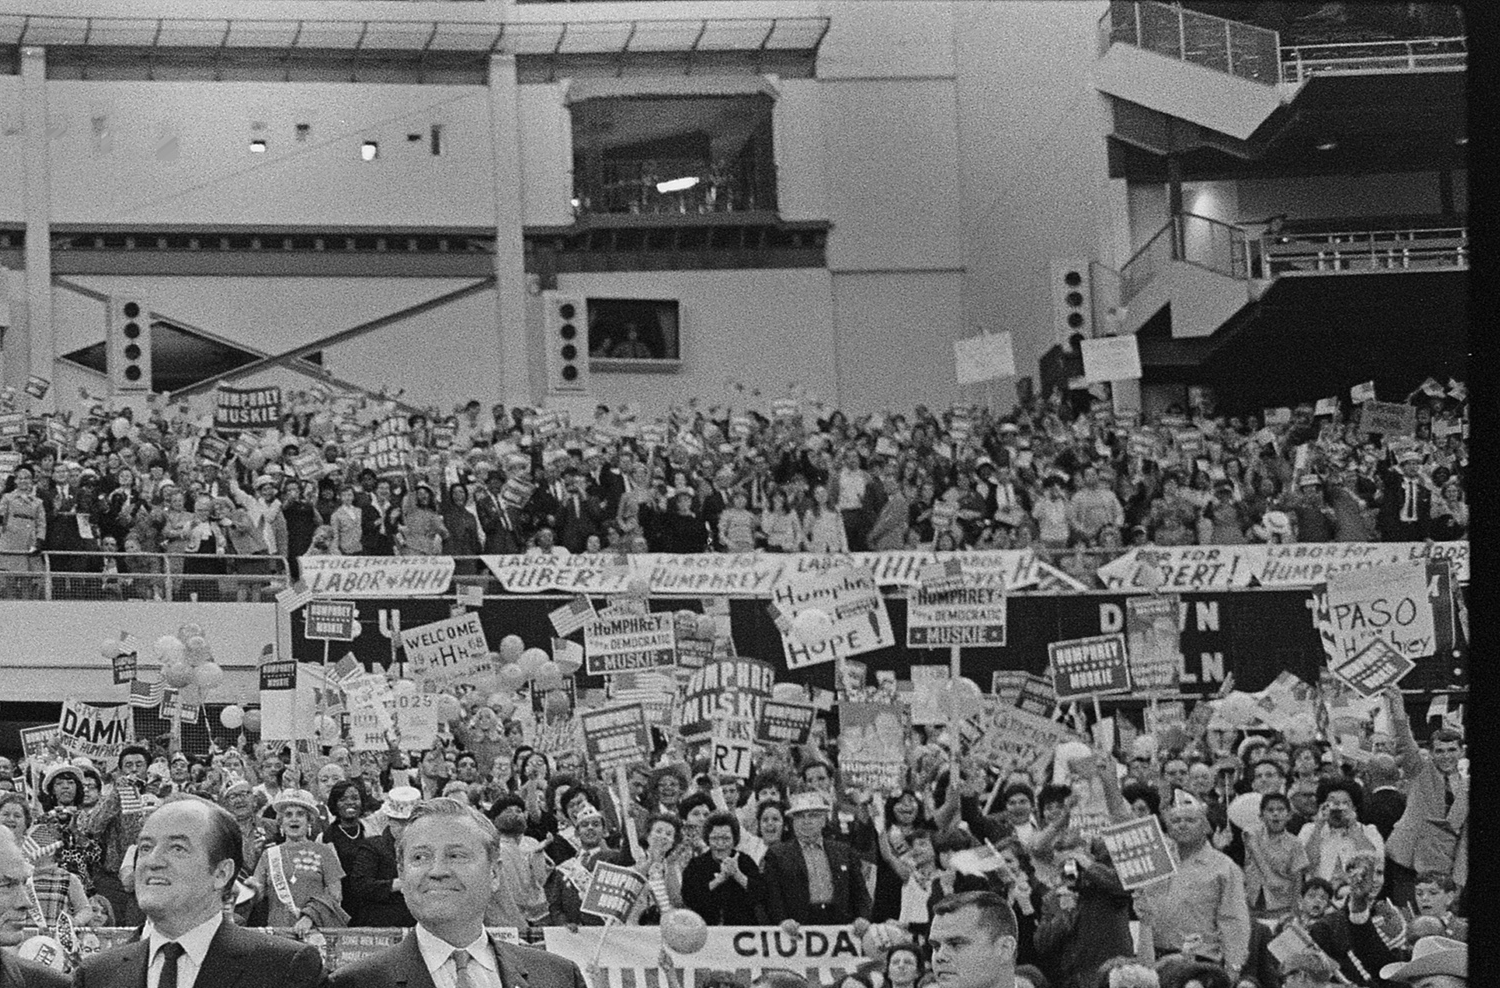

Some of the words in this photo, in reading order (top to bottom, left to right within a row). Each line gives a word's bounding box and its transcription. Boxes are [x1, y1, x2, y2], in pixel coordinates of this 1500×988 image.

[217, 406, 279, 423] MUSKIE
[498, 555, 561, 567] LABOR
[1266, 546, 1337, 558] LABOR
[311, 570, 385, 593] LABOR
[398, 569, 450, 591] HHH
[1334, 597, 1418, 630] PASO
[405, 620, 480, 650] WELCOME
[925, 624, 987, 643] MUSKIE
[603, 649, 659, 670] MUSKIE
[682, 692, 761, 726] MUSKI
[62, 706, 129, 745] DAMN
[714, 743, 749, 775] RT
